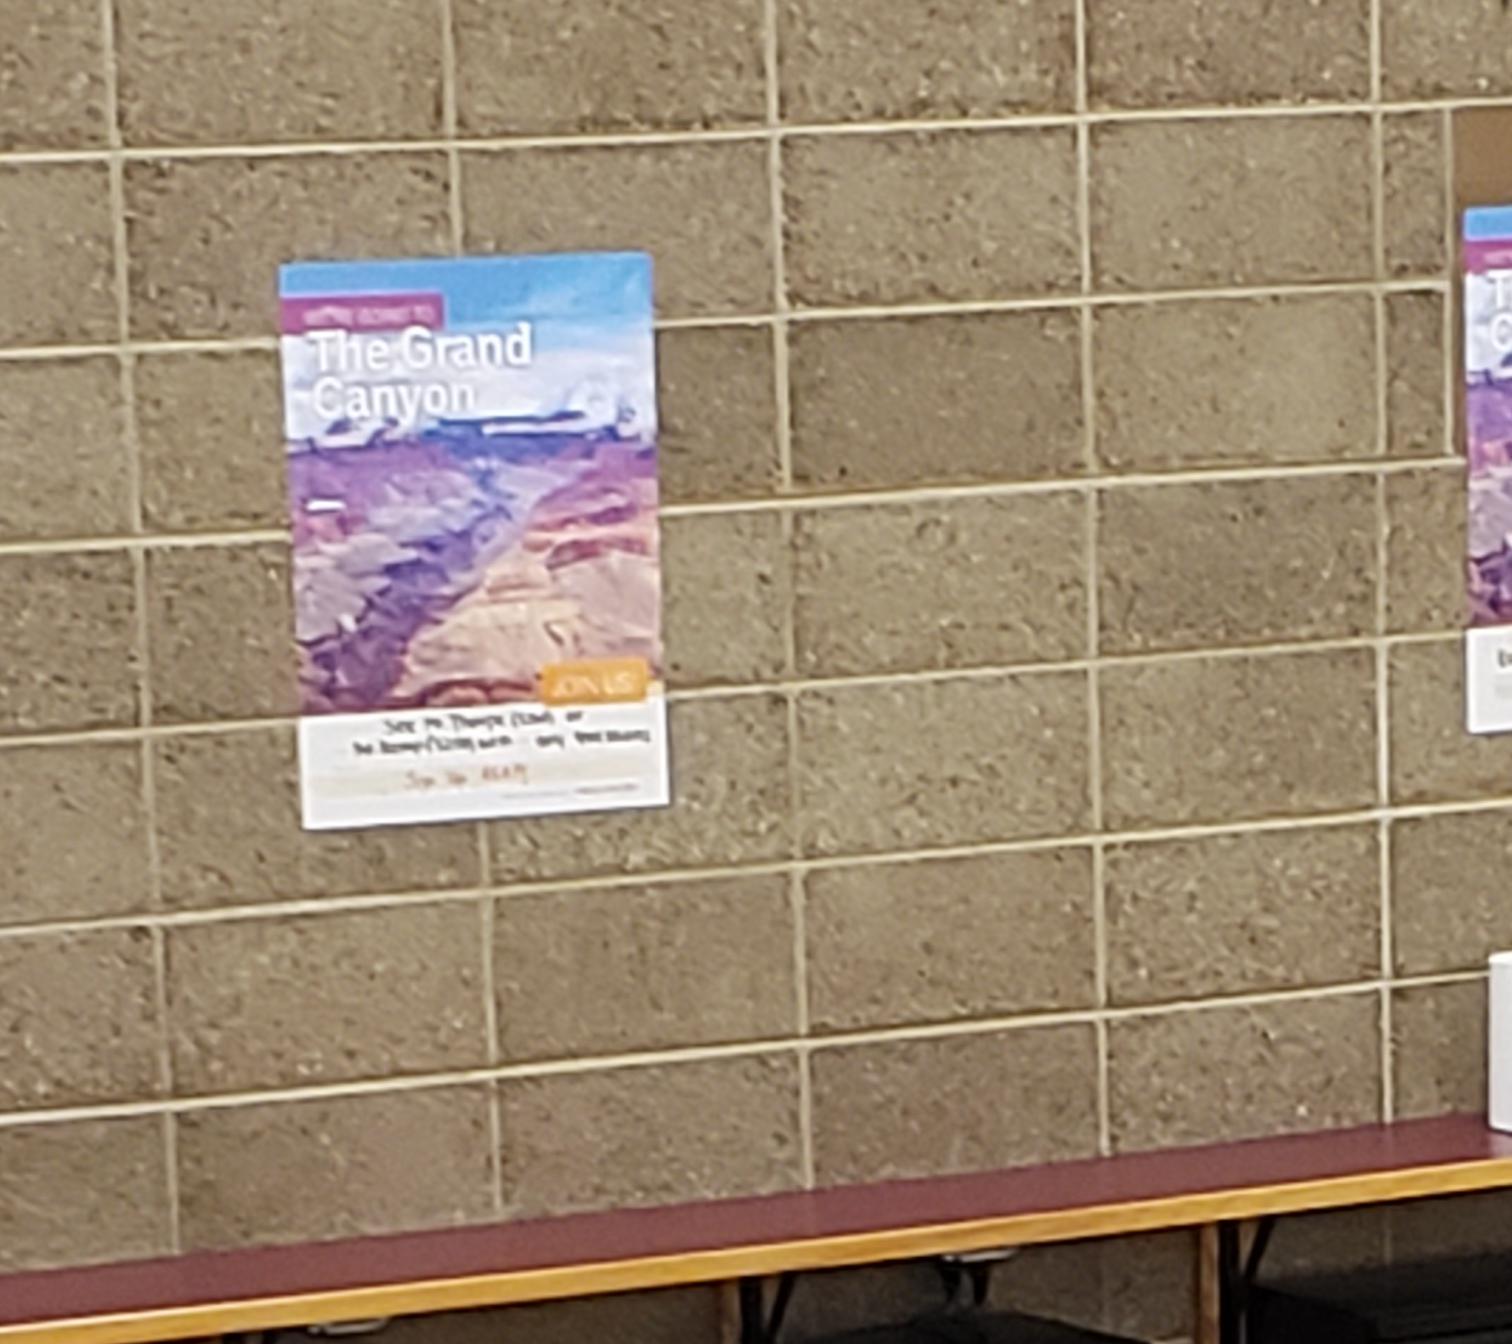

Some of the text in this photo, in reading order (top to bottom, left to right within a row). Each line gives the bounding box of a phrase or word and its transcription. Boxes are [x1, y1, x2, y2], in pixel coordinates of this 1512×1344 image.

[306, 321, 532, 372] The Grand
[313, 376, 475, 428] Canyon
